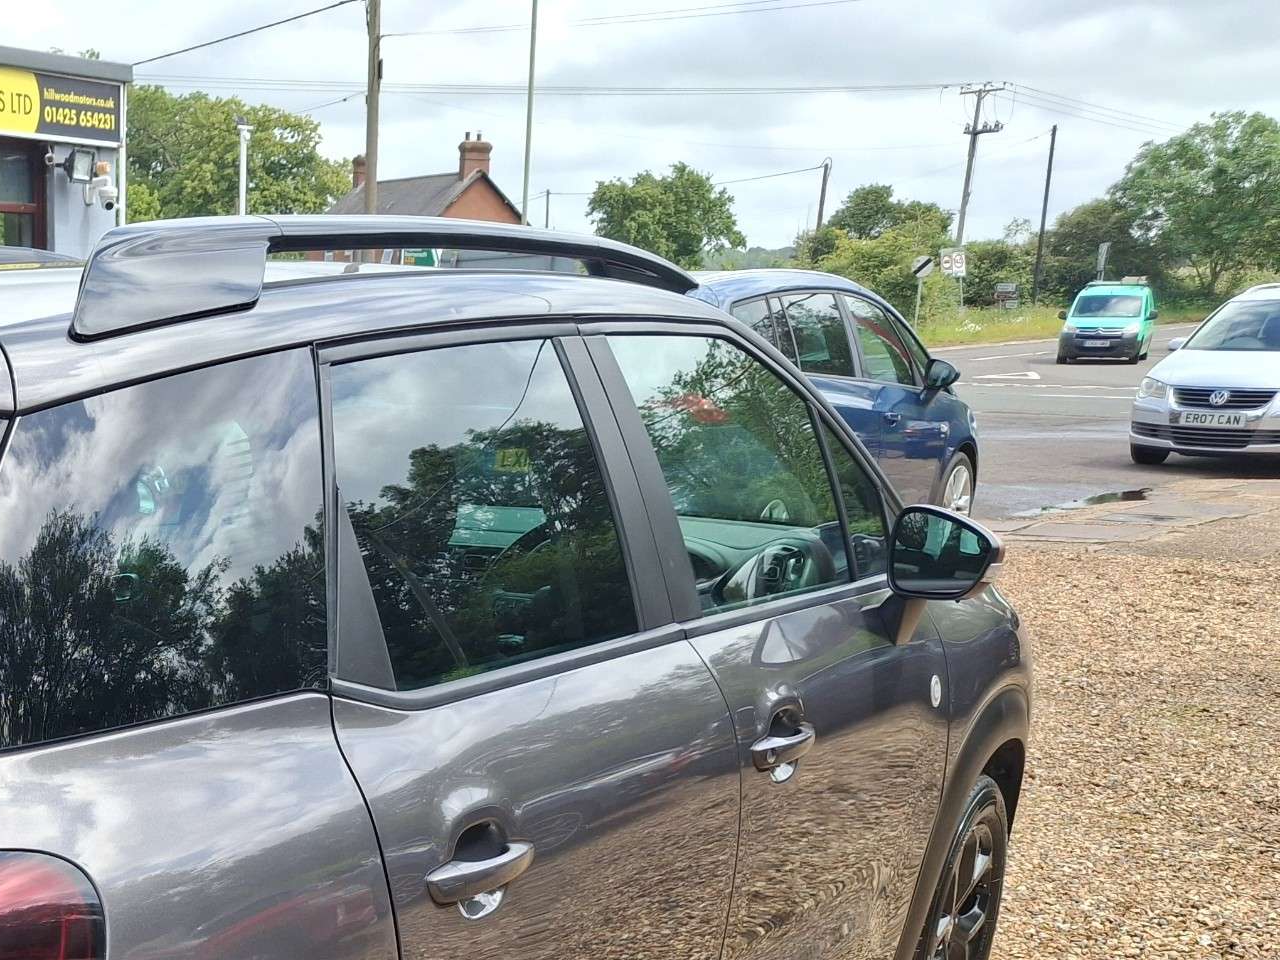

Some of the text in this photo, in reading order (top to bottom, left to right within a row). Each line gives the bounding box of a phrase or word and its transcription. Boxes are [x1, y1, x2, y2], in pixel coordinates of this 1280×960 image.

[11, 93, 33, 115] LTD
[43, 88, 115, 109] hillwoodmotors.co.uk
[44, 106, 116, 131] 01425 654231
[1185, 413, 1241, 426] ER07 CAN
